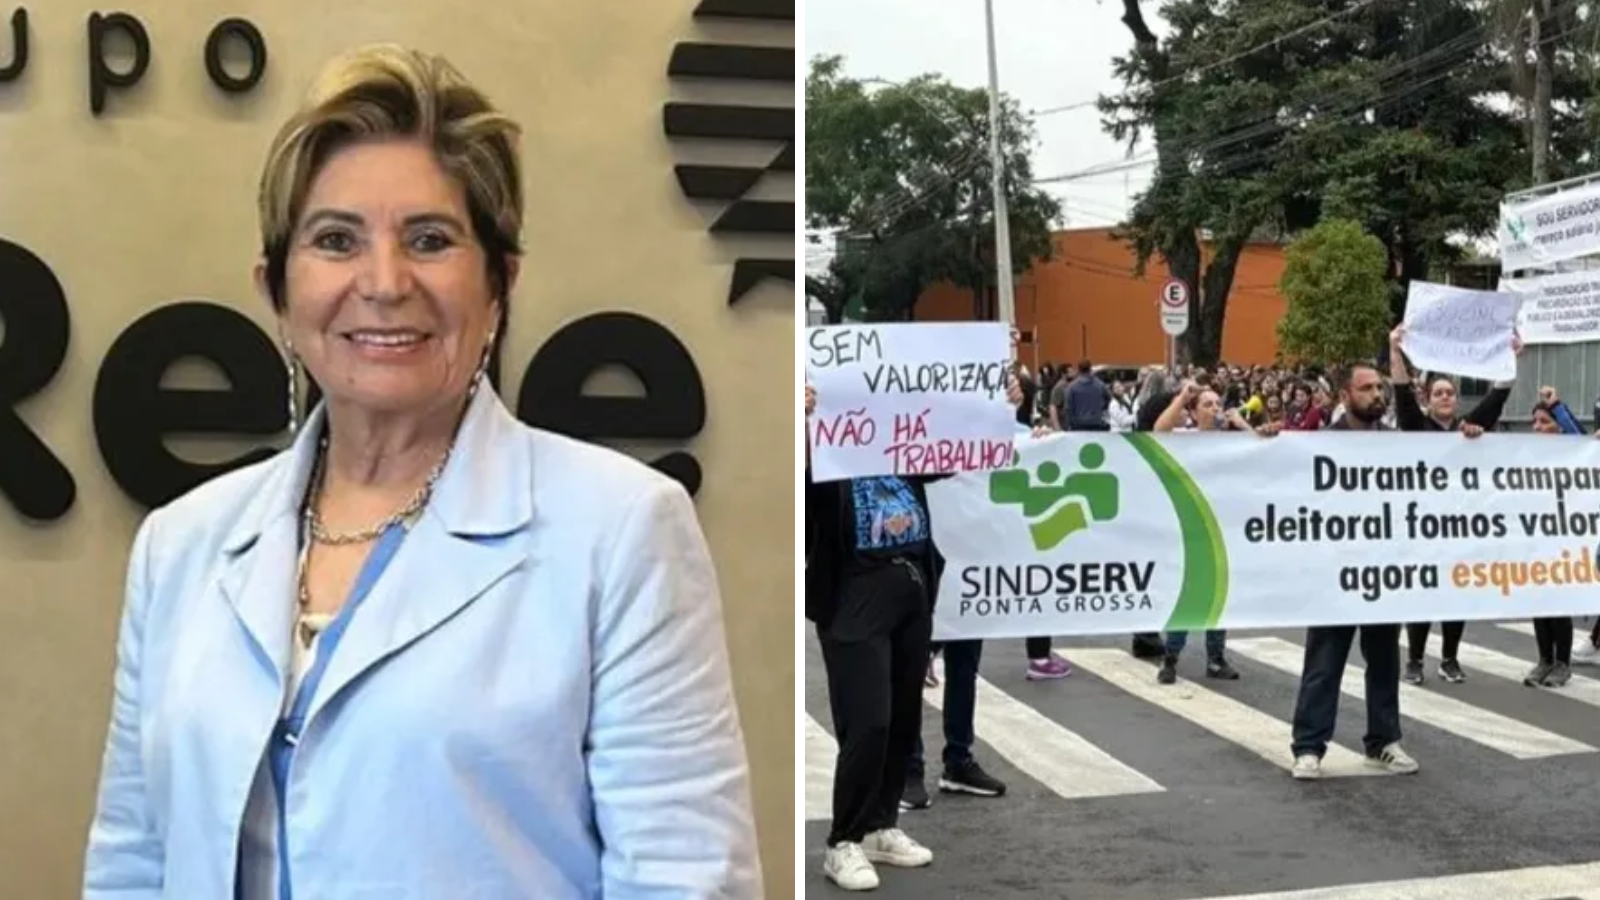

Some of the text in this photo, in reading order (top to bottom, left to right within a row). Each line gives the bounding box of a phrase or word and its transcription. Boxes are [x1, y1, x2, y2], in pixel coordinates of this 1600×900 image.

[809, 328, 882, 368] SEM
[815, 407, 876, 447] NÃO
[894, 408, 931, 442] HÁ
[884, 438, 1014, 475] TRABALHO!
[1313, 455, 1449, 493] Durante
[1460, 466, 1480, 491] a
[1244, 500, 1600, 543] eleitoral fomos valor
[961, 561, 1156, 599] SINDSERV
[1339, 563, 1439, 602] agora
[960, 593, 1153, 617] PONTA GROSSA
